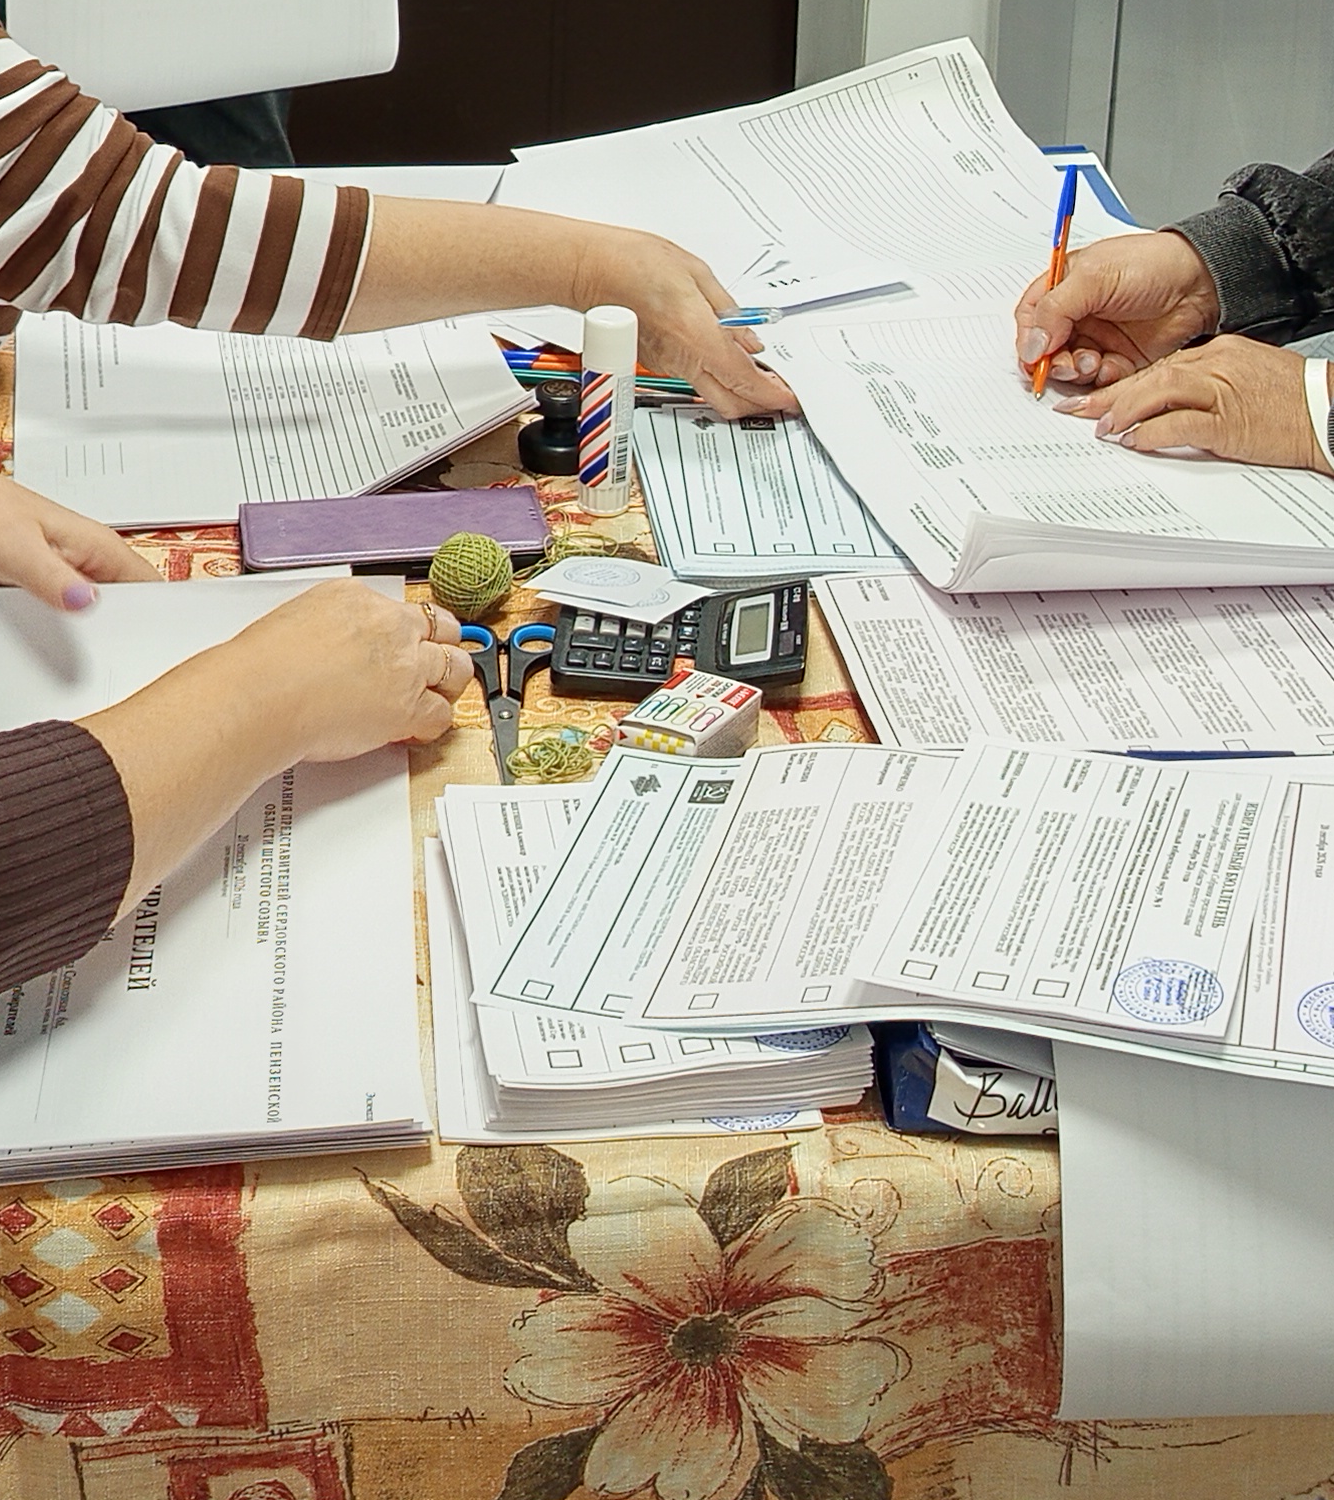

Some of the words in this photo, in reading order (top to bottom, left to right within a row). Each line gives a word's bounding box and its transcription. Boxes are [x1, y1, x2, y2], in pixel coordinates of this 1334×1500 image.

[260, 803, 276, 845] ОБЛАСТИ
[1226, 801, 1259, 871] ИЗБИРАТЕЛЬНЫЙ
[257, 847, 274, 897] ШЕСТОГО
[275, 813, 292, 900] ПРЕДСТАВИТЕЛЕЙ
[229, 893, 243, 910] года
[254, 899, 271, 944] СОЗЫВА
[1210, 871, 1239, 929] БЮЛЛЕТЕНЬ
[270, 904, 289, 985] СЕРДОБСКОГО
[268, 988, 287, 1034] РАЙОНА
[264, 1041, 282, 1124] ПЕНЗЕНСКОЙ
[954, 1072, 1058, 1126] Ball
